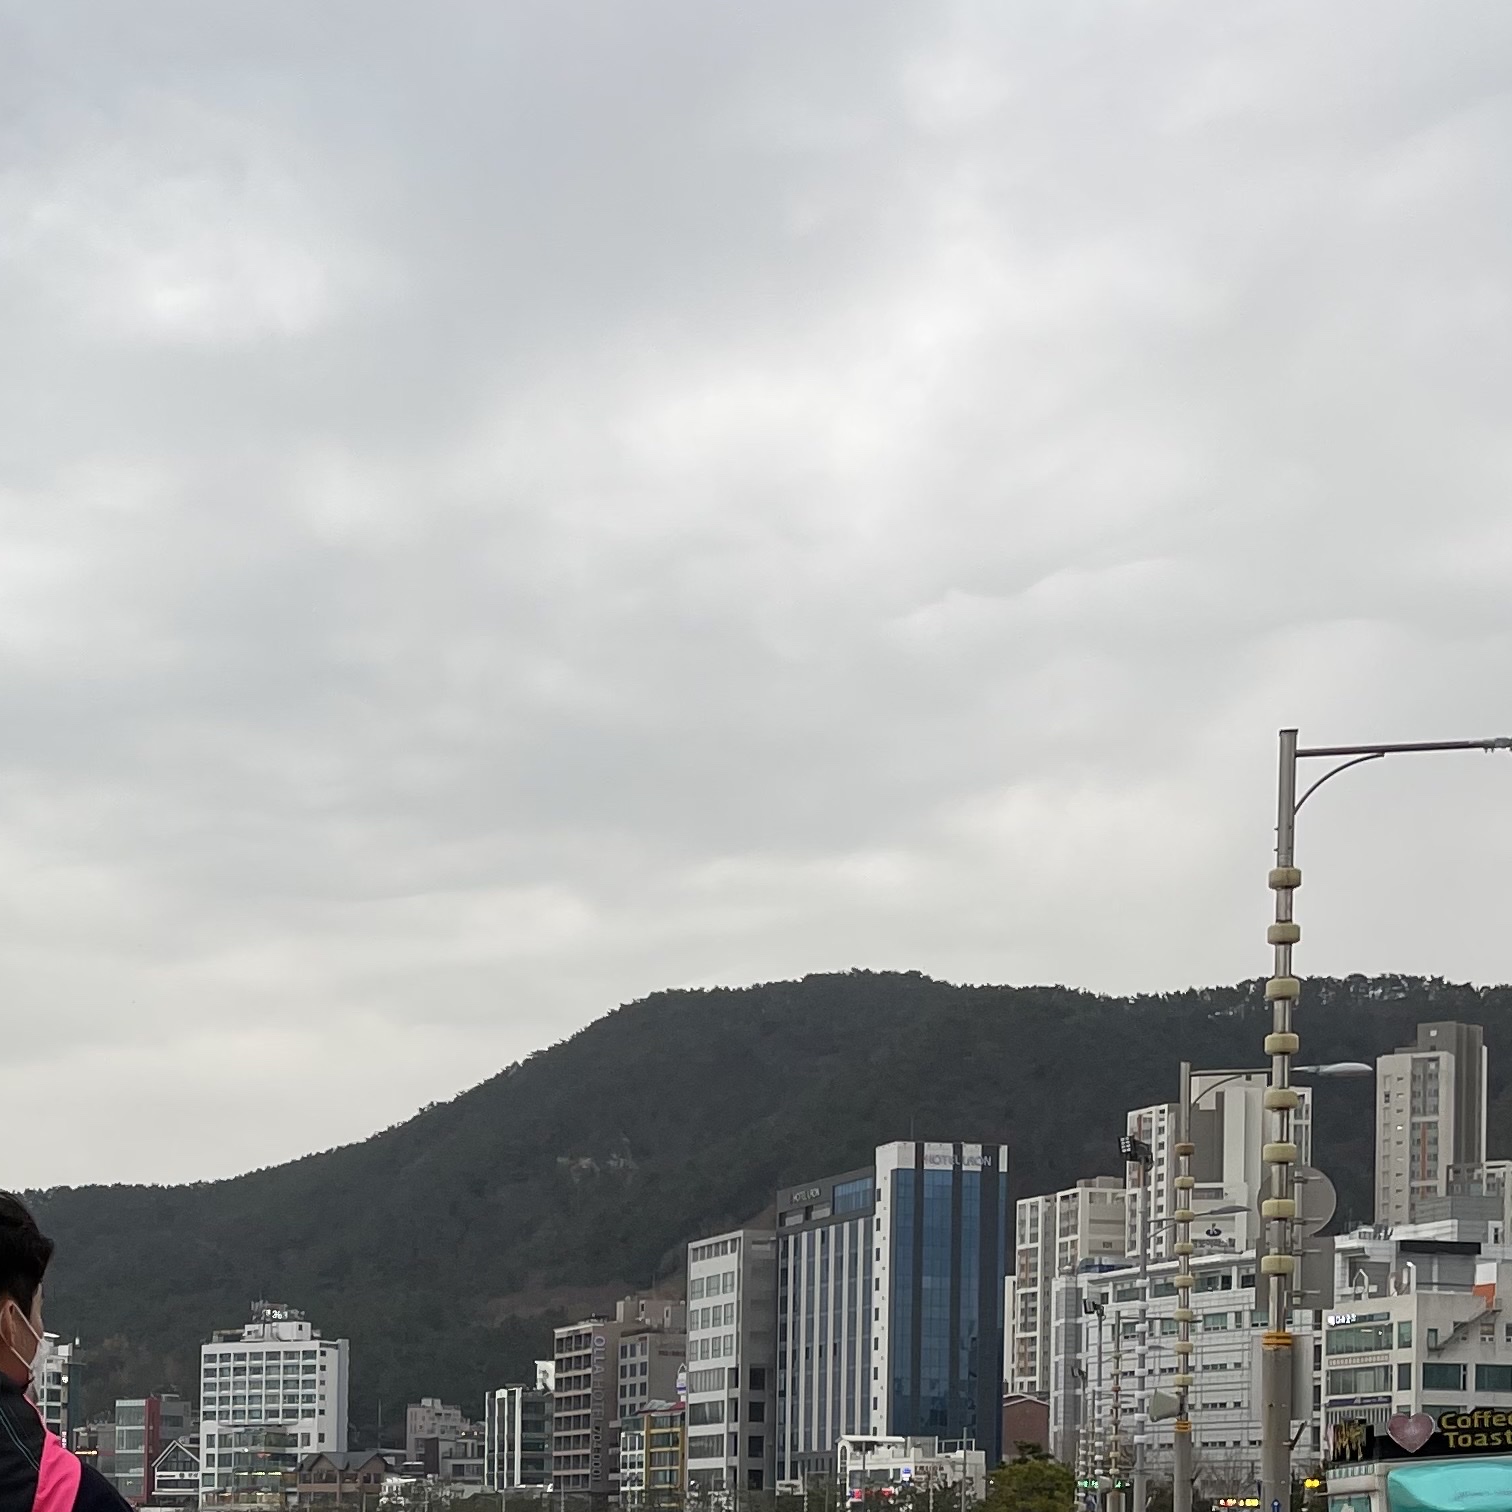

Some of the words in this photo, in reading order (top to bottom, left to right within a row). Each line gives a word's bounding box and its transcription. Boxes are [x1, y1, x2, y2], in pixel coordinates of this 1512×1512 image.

[923, 1154, 960, 1165] HOTEL
[792, 1190, 807, 1202] HOTEL
[593, 1335, 606, 1375] OLLA
[592, 1378, 605, 1423] HOTEL
